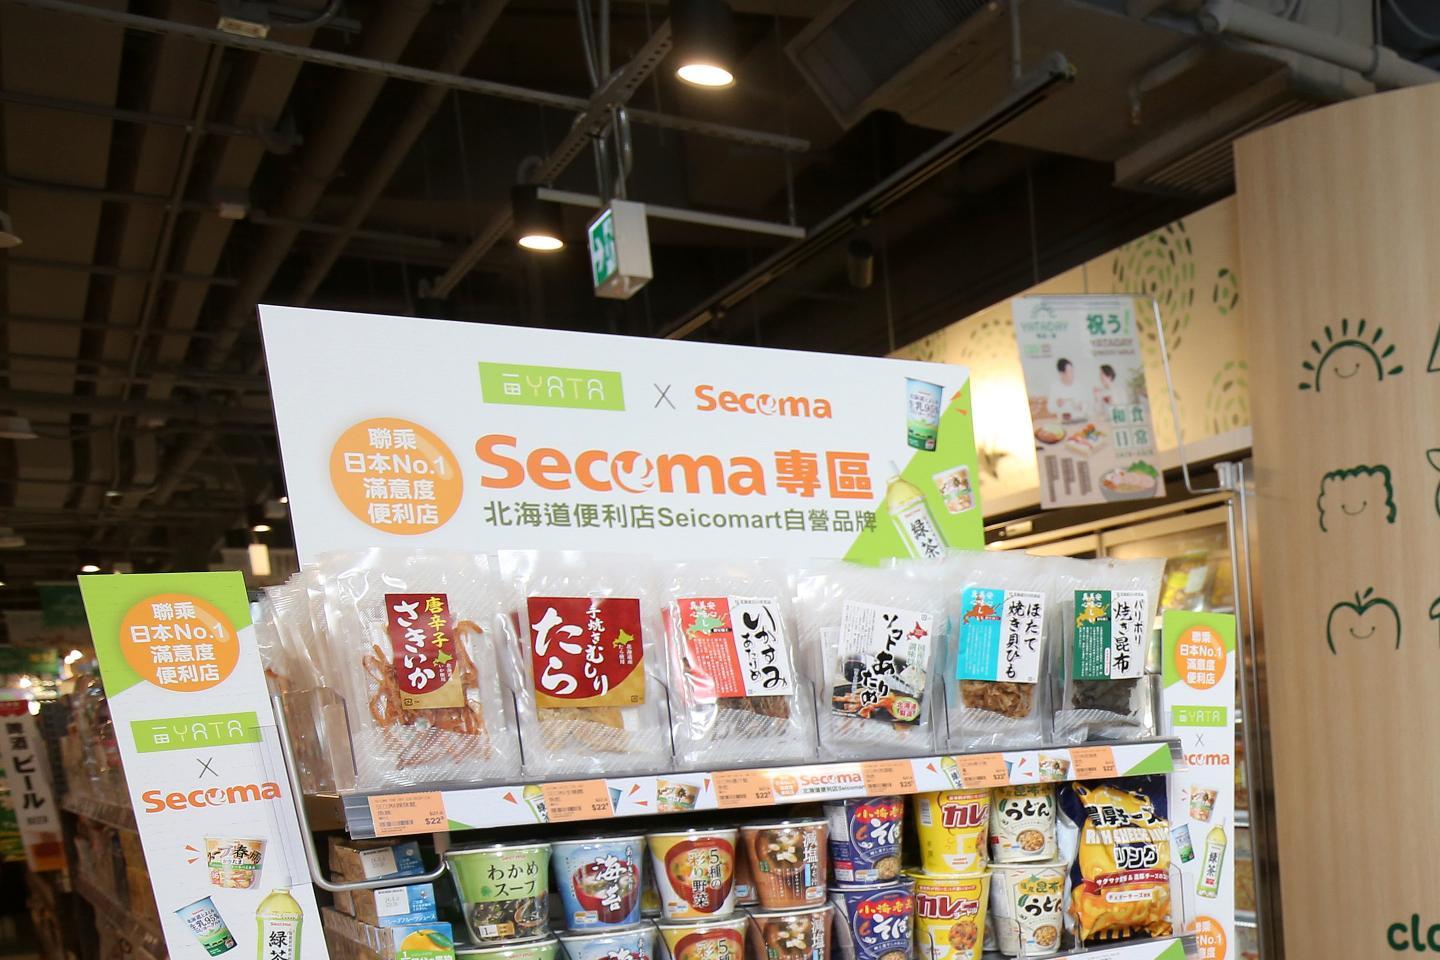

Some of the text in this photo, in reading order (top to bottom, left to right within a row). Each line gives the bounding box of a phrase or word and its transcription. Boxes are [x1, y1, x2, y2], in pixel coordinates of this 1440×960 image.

[693, 384, 833, 420] Secoma
[368, 428, 418, 451] 聯乘
[344, 453, 446, 479] 日本No.1
[364, 476, 436, 501] 滿意度
[367, 502, 440, 527] 便利店
[483, 500, 878, 535] 北海道便利店Seicomart自營品牌
[152, 602, 196, 620] 聯乘
[424, 597, 450, 648] 唐辛子
[130, 622, 226, 644] 日本No.1
[1026, 603, 1040, 653] ほたて
[1112, 601, 1132, 672] 焼き昆布
[150, 644, 216, 663] 滿意度
[393, 599, 435, 690] さきいか
[532, 607, 584, 696] たら
[155, 663, 220, 684] 便利店
[142, 782, 281, 813] Secoma
[1006, 799, 1050, 821] うどん
[709, 849, 721, 890] 5種の
[1115, 845, 1159, 869] リング
[488, 862, 539, 880] わかめ
[495, 880, 537, 898] スープ
